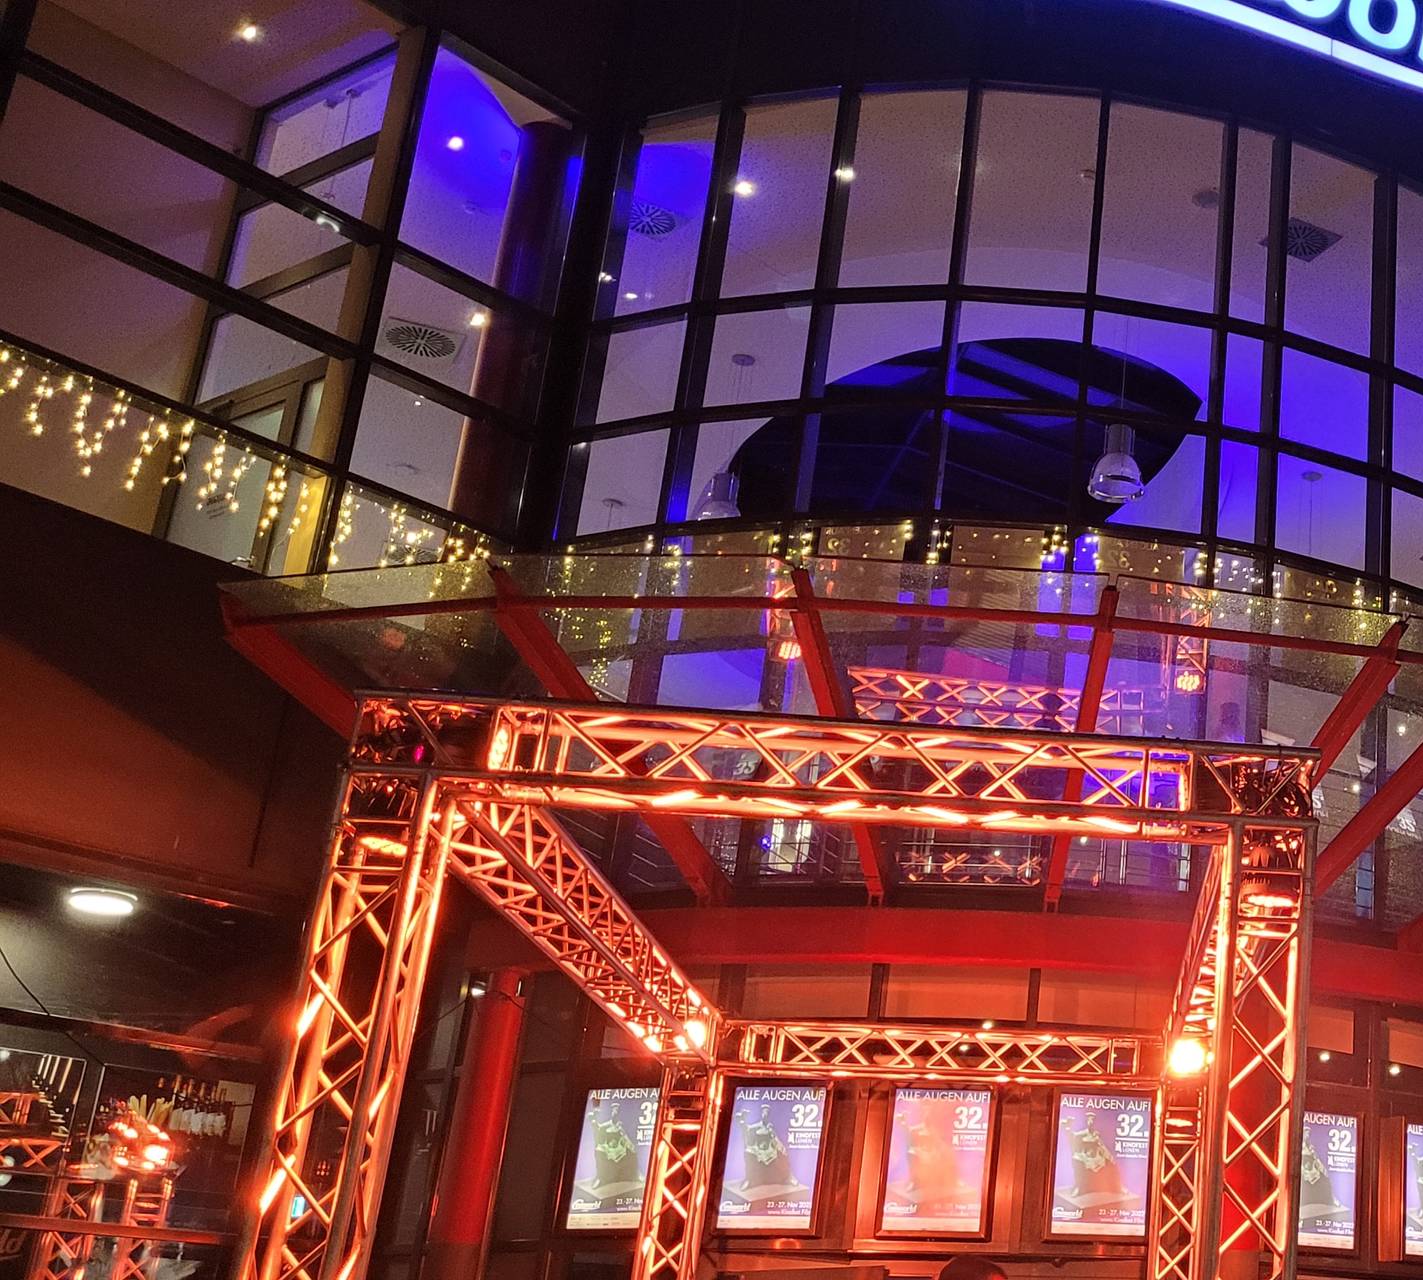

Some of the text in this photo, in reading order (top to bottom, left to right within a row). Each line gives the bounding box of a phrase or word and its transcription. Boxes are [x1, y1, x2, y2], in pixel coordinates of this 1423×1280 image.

[590, 1089, 610, 1099] ALLE
[612, 1088, 648, 1099] AUGEN
[737, 1090, 760, 1100] ALLE
[762, 1090, 800, 1100] AUGEN
[897, 1091, 920, 1101] ALLE
[924, 1091, 963, 1101] AUGEN
[1061, 1097, 1084, 1108] ALLE
[1086, 1098, 1125, 1110] AUGEN
[789, 1103, 822, 1128] 32.
[953, 1105, 988, 1129] 32.
[1303, 1112, 1335, 1126] AUGEN
[1116, 1113, 1148, 1137] 32.
[1407, 1123, 1423, 1135] ALLE
[1327, 1128, 1356, 1152] 32.
